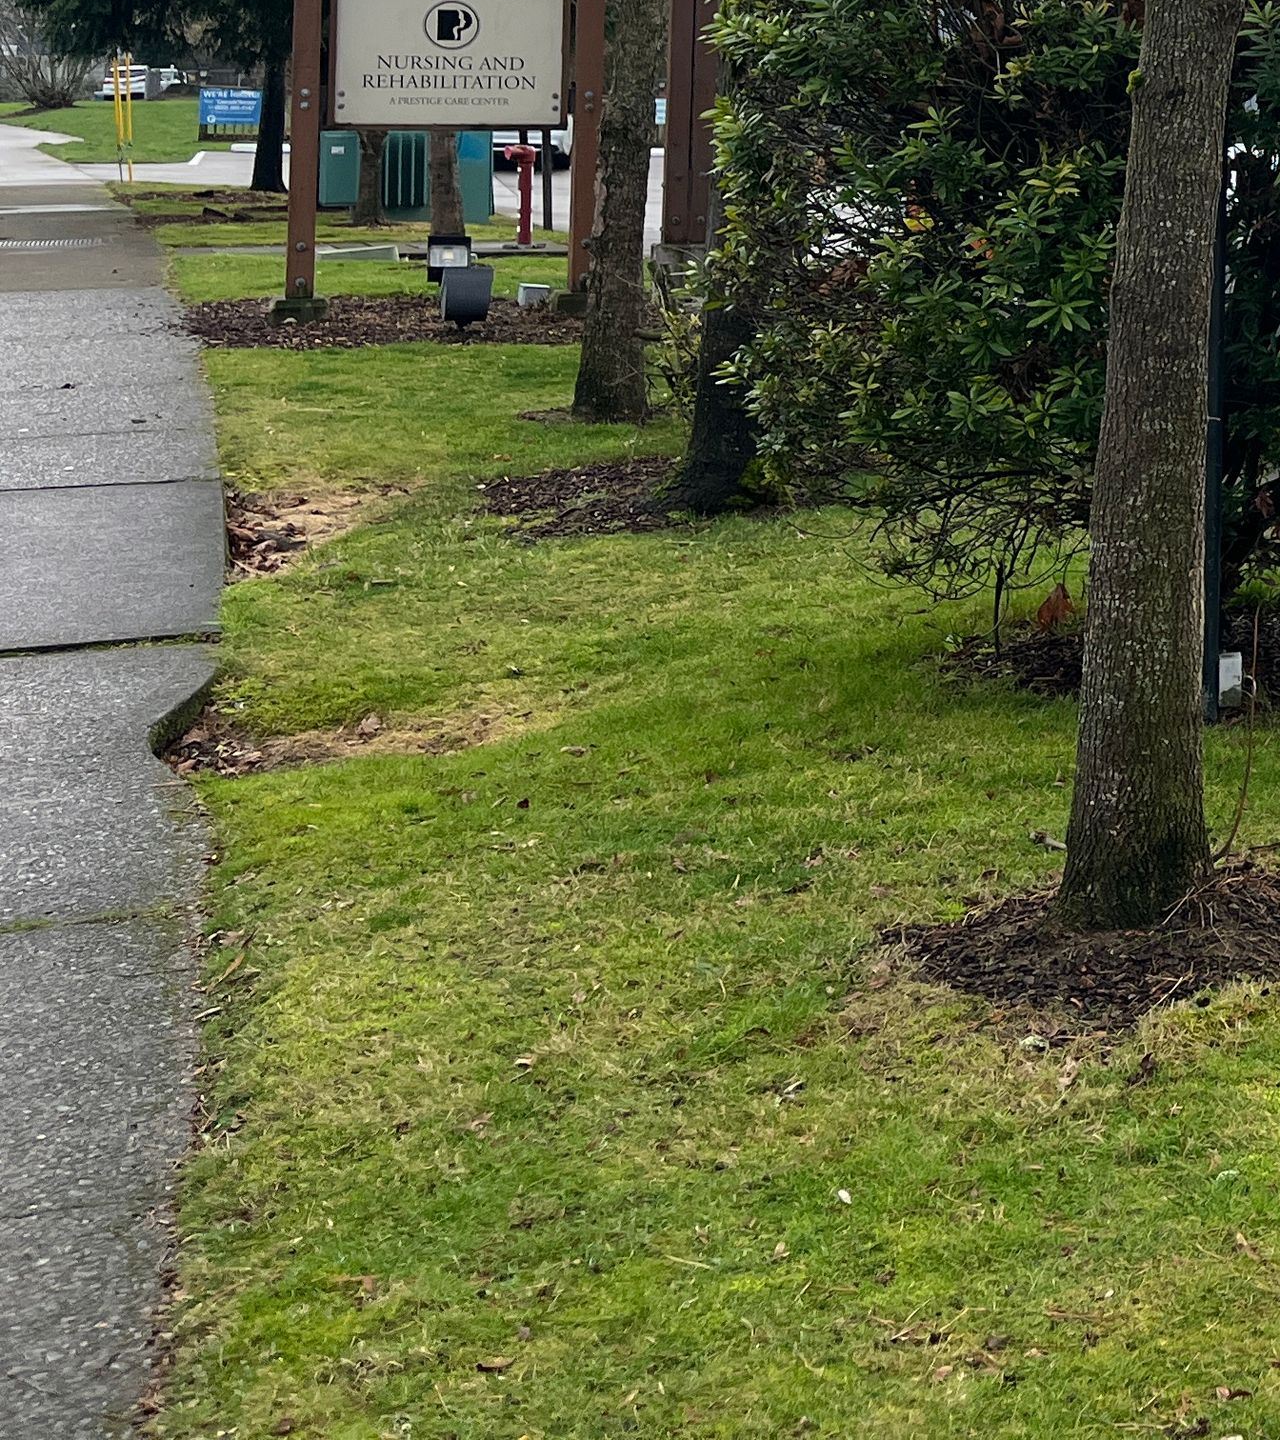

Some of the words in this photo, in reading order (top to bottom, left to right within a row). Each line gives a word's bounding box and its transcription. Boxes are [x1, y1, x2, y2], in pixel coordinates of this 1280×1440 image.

[377, 55, 472, 70] NURSING
[478, 57, 525, 71] AND
[362, 74, 536, 90] REHABILITATION
[398, 97, 441, 106] PRESTIGE
[444, 97, 469, 106] CARE
[470, 97, 510, 106] CENTER
